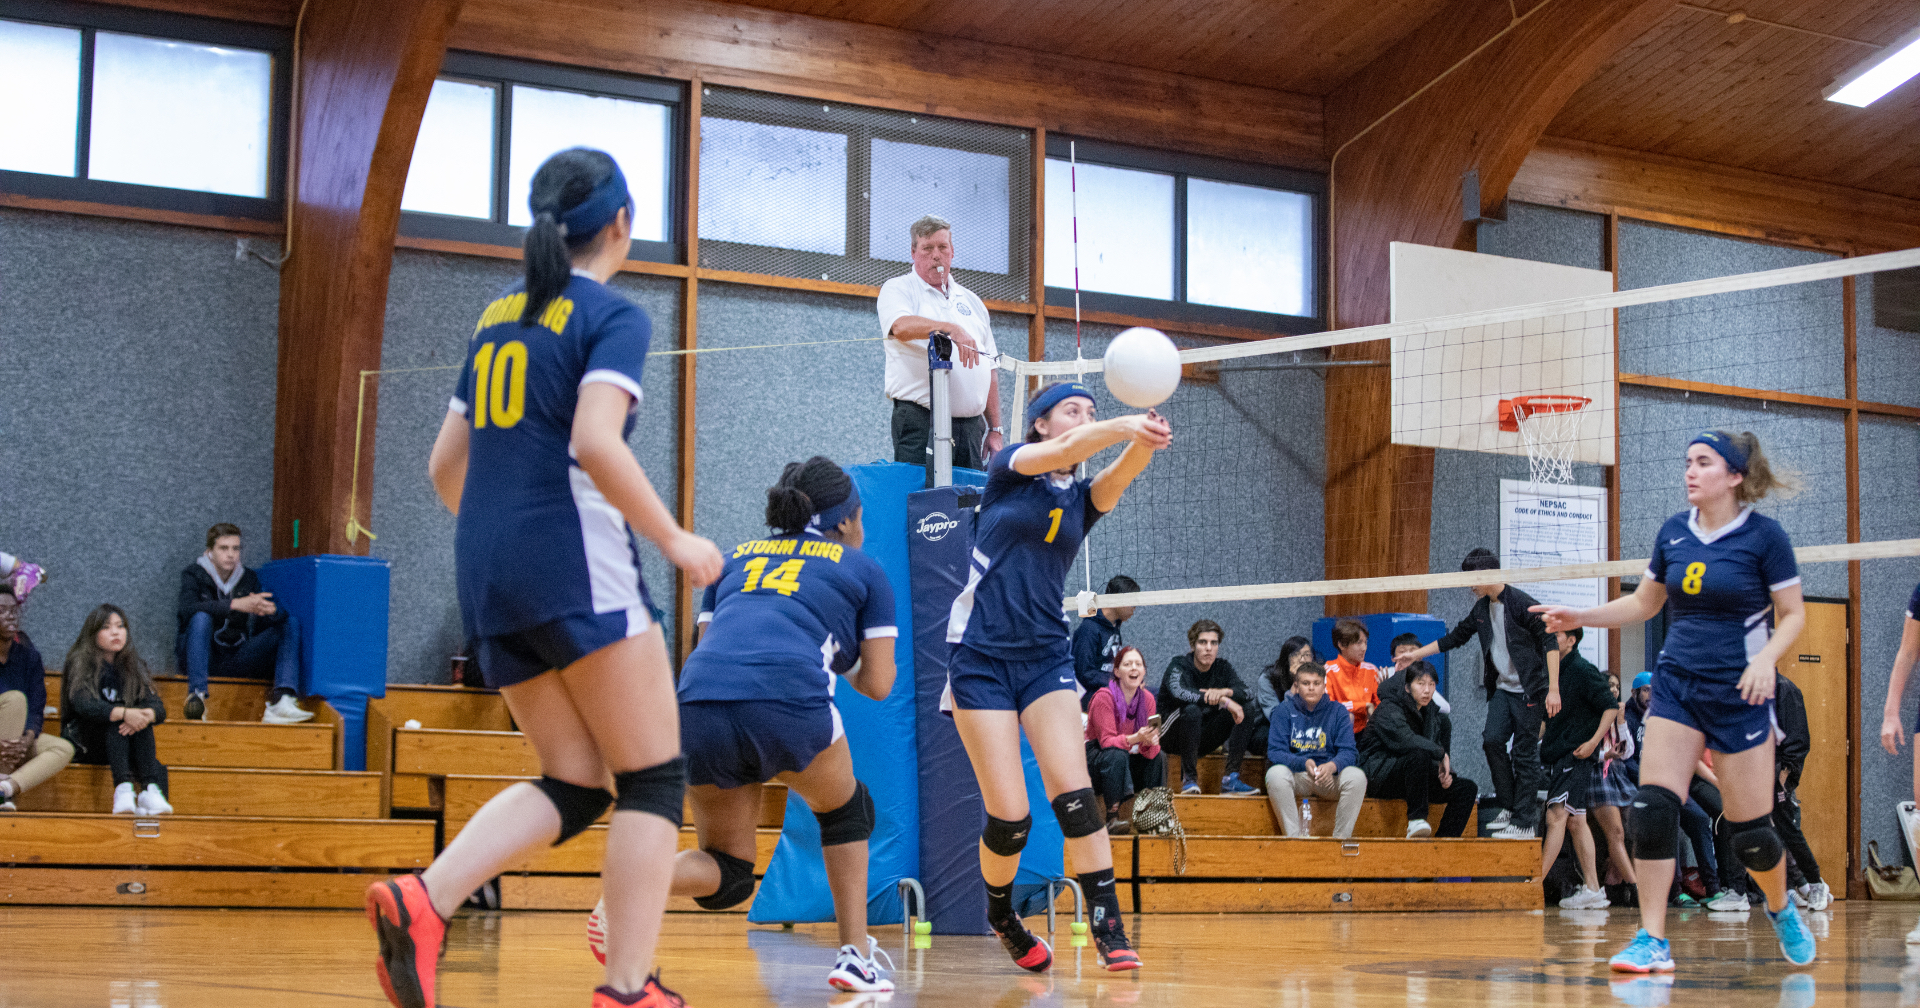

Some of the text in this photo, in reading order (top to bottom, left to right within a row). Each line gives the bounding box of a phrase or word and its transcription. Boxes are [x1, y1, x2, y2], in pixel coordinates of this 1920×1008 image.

[538, 295, 574, 335] NG
[473, 340, 528, 428] 10
[1514, 507, 1529, 515] CODE
[1538, 509, 1556, 517] ETHICS
[1568, 512, 1593, 520] CONDUCT
[1539, 500, 1567, 510] NEPSAC
[916, 518, 958, 533] Jaypro
[1044, 508, 1064, 543] 1
[732, 539, 844, 563] STORM KING
[741, 556, 806, 596] 14
[1682, 561, 1707, 595] 8
